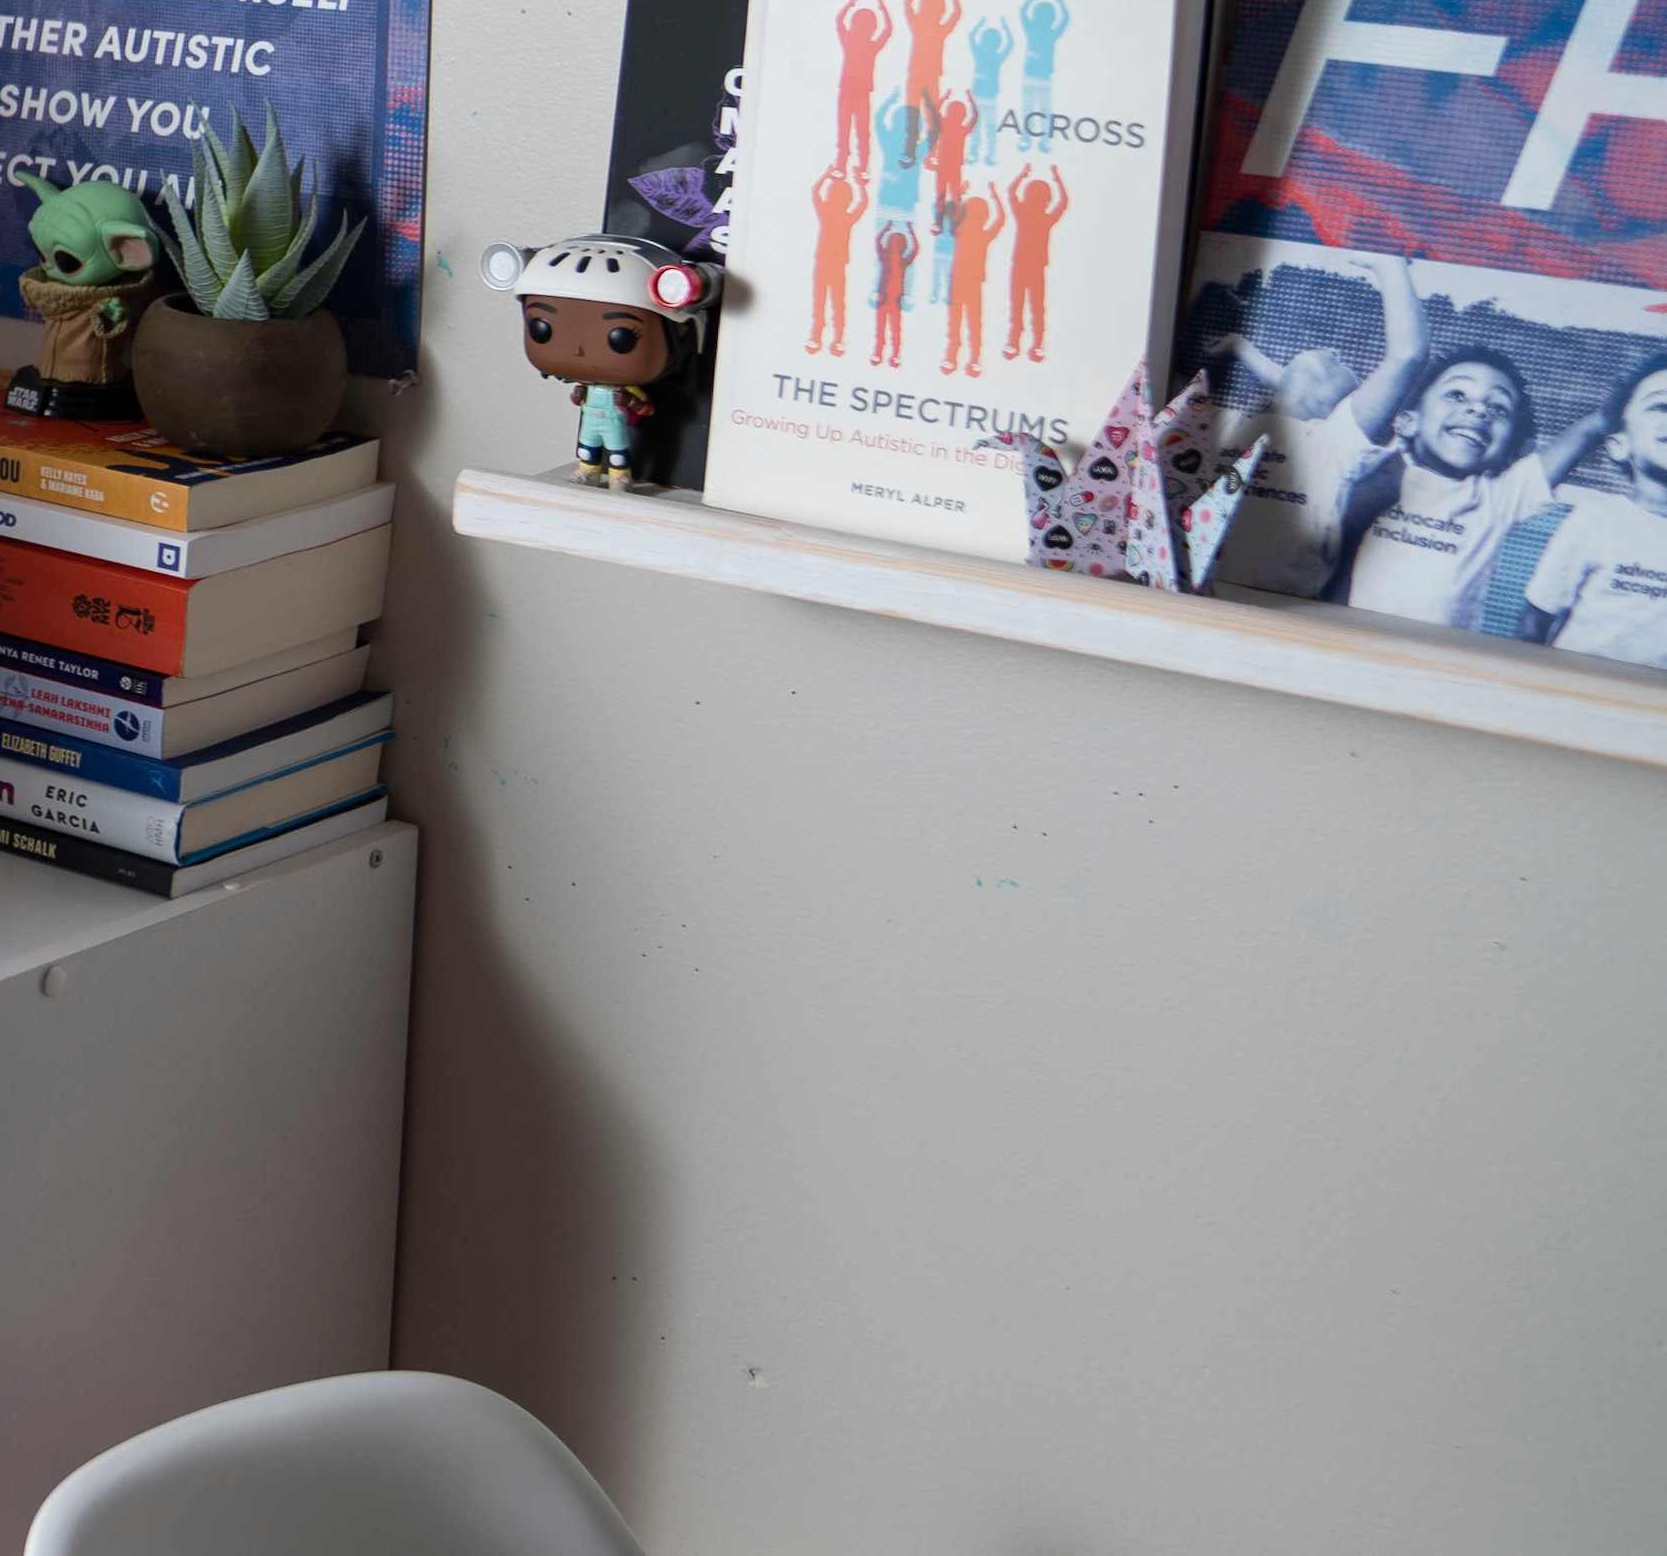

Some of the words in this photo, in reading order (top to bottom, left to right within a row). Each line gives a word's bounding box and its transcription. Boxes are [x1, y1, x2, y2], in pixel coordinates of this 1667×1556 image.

[94, 25, 276, 76] AUTISTIC
[126, 97, 210, 140] YOU
[996, 107, 1146, 150] ACROSS
[9, 386, 38, 400] STAR
[772, 373, 839, 409] THE
[849, 386, 1070, 445] SPECTRUMS
[731, 409, 809, 440] Growing
[815, 423, 843, 445] Up
[849, 429, 925, 457] Autistic
[929, 442, 950, 460] in
[953, 445, 988, 468] the
[40, 465, 62, 480] KELLY
[851, 481, 905, 504] MERYL
[910, 492, 966, 515] ALPER
[1372, 526, 1458, 555] inclusion
[21, 651, 56, 669] RENEE
[58, 661, 99, 680] TAYLOR
[31, 689, 58, 704] LEAH
[61, 694, 112, 719] LAKSHMI
[2, 732, 48, 759] ELIZABETH
[49, 745, 82, 768] GUFFEY
[45, 785, 89, 808] ERIC
[31, 804, 101, 835] GARCIA
[13, 832, 58, 860] SCHALK
